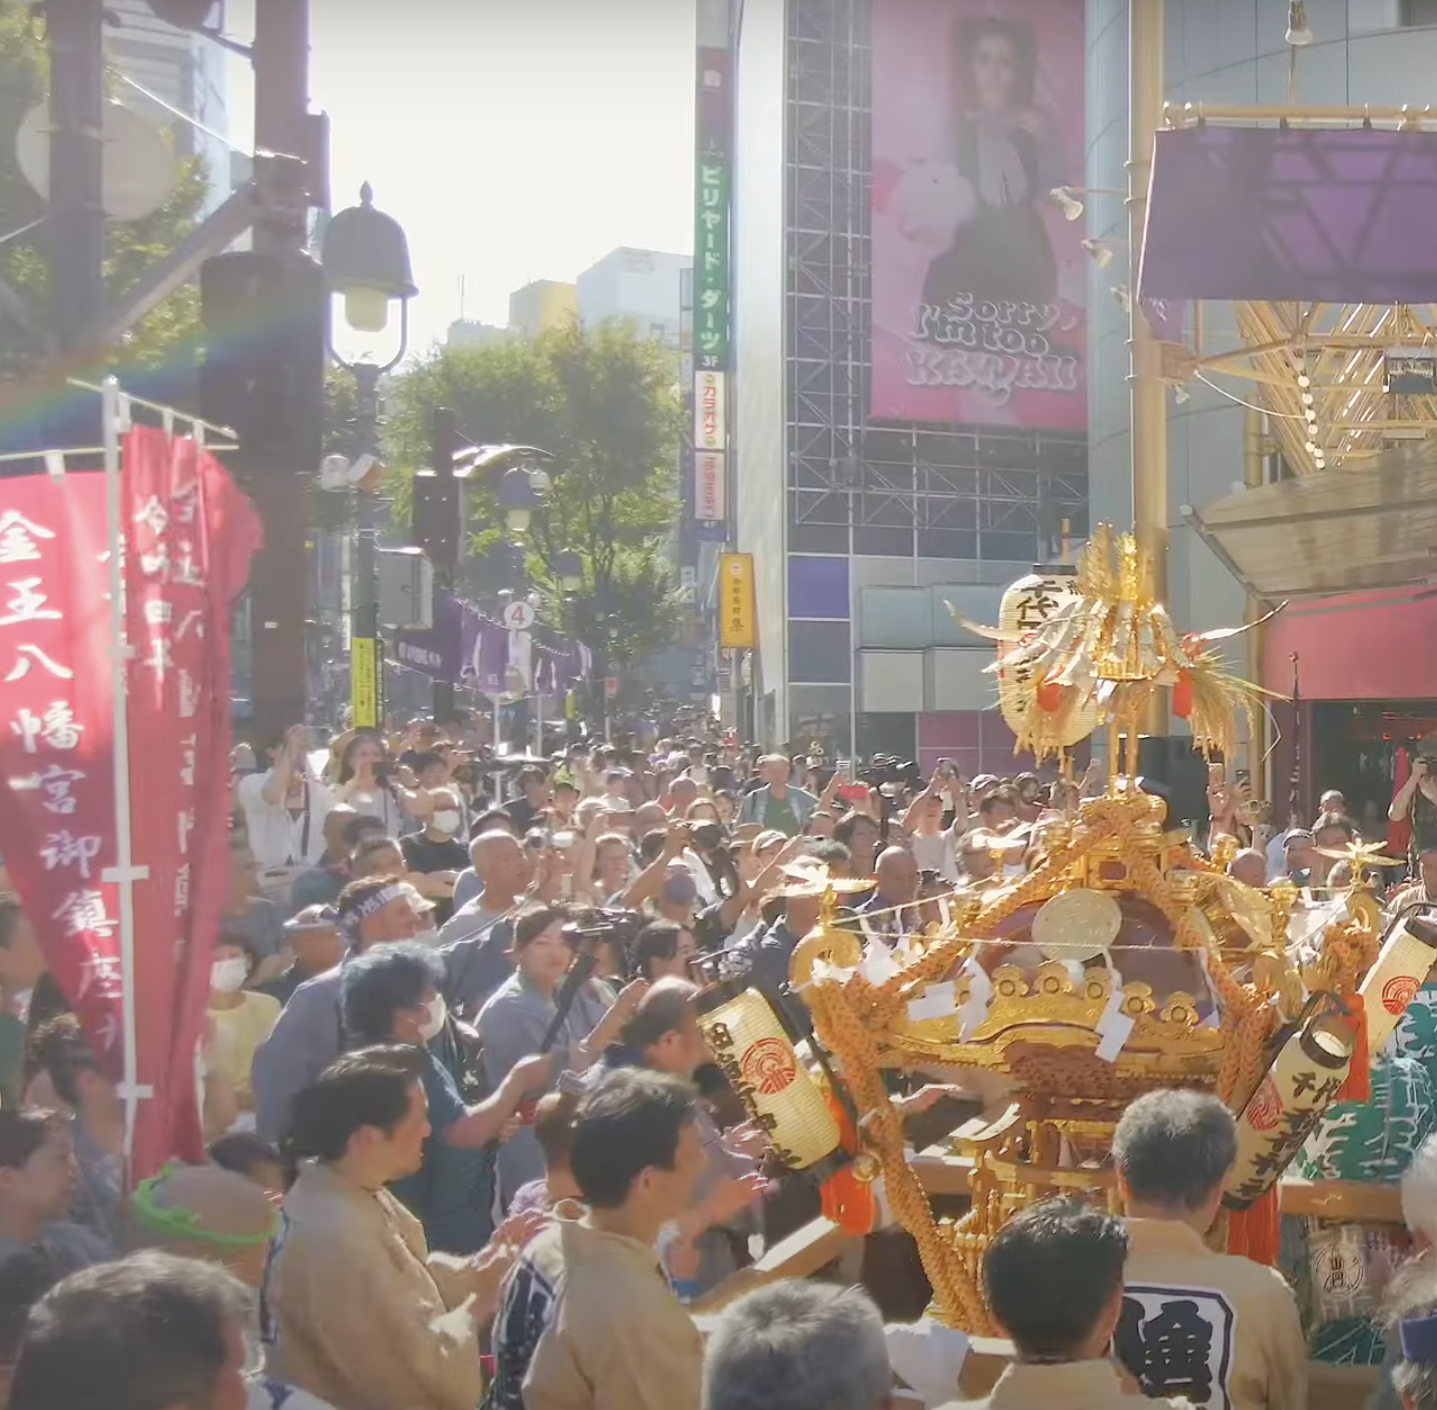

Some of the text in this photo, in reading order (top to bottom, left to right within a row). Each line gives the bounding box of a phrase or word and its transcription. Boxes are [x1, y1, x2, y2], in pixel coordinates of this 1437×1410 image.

[700, 165, 722, 350] ビリヤード・ダーツ
[947, 292, 1076, 333] Sorry,
[982, 320, 1050, 357] too
[702, 355, 719, 367] 3F
[511, 605, 525, 625] 4
